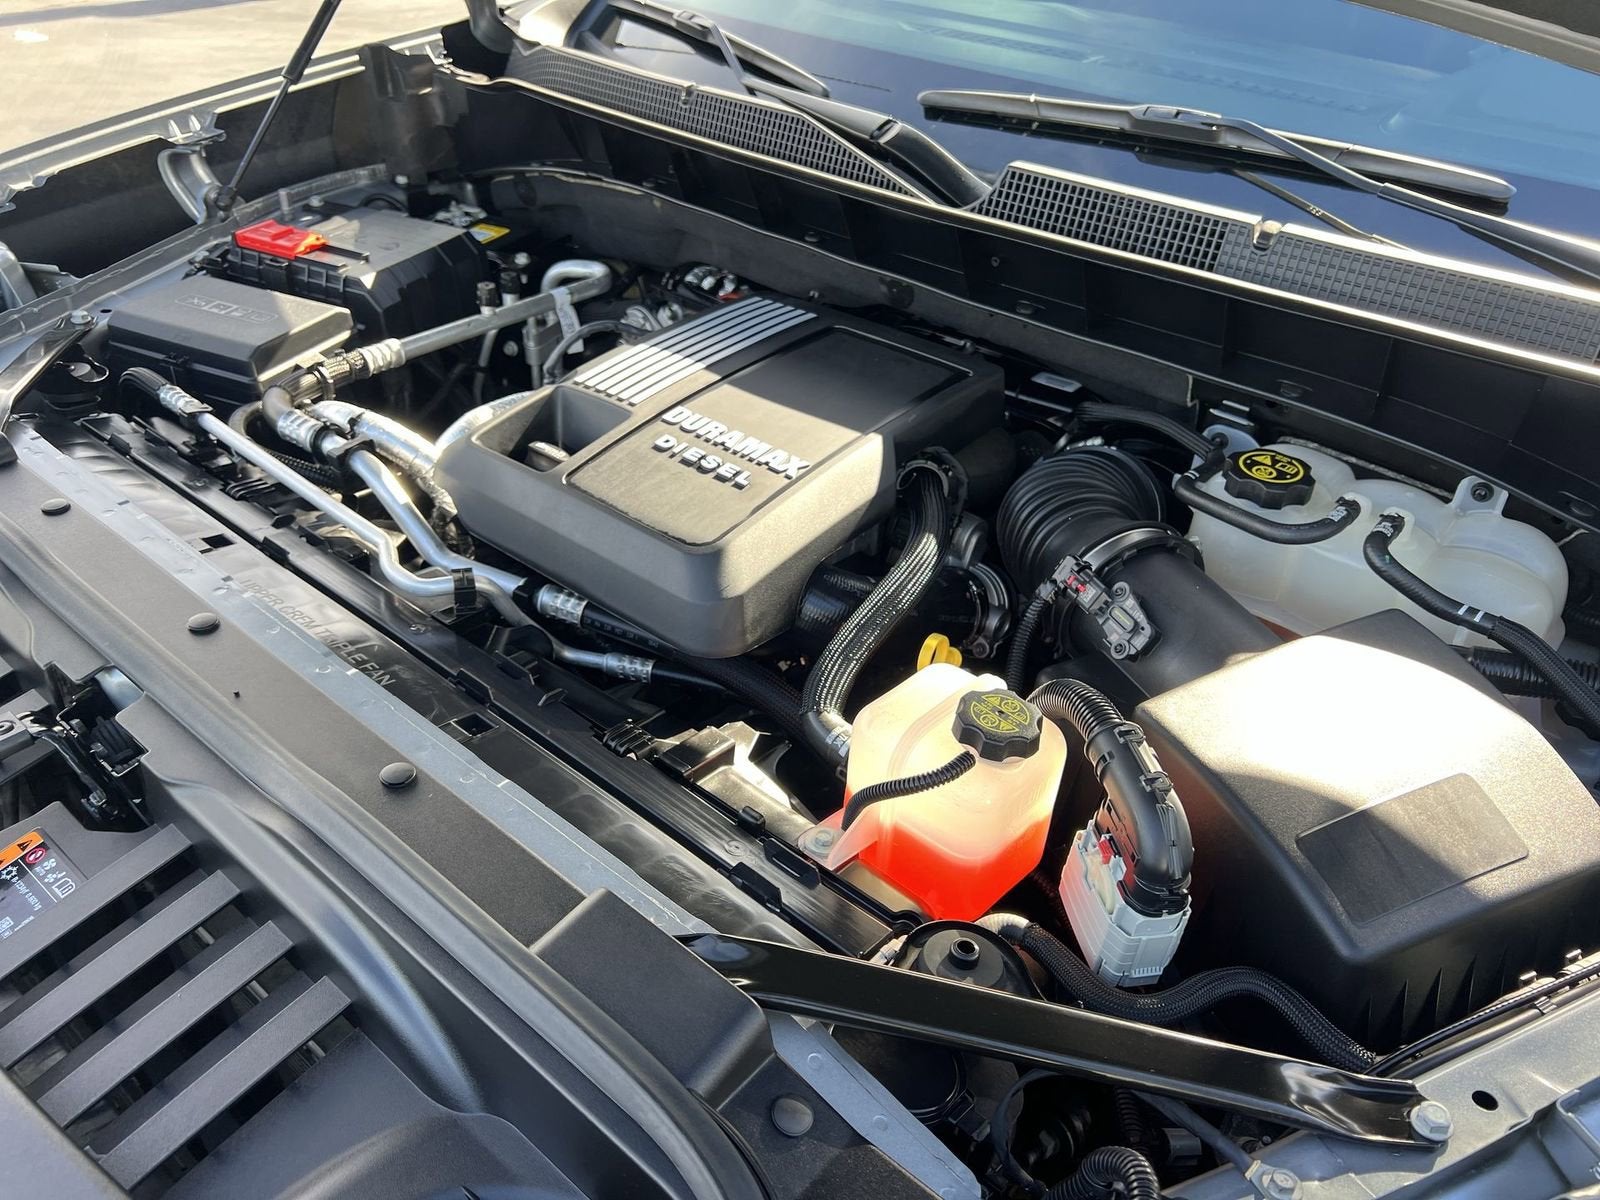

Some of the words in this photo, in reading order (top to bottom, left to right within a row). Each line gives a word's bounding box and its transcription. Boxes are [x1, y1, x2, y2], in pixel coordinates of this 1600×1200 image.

[653, 433, 751, 490] DIESEL
[661, 406, 810, 480] DURAMAX
[242, 579, 284, 607] UPPER
[315, 628, 369, 663] TRIPLE
[359, 662, 396, 687] FAN
